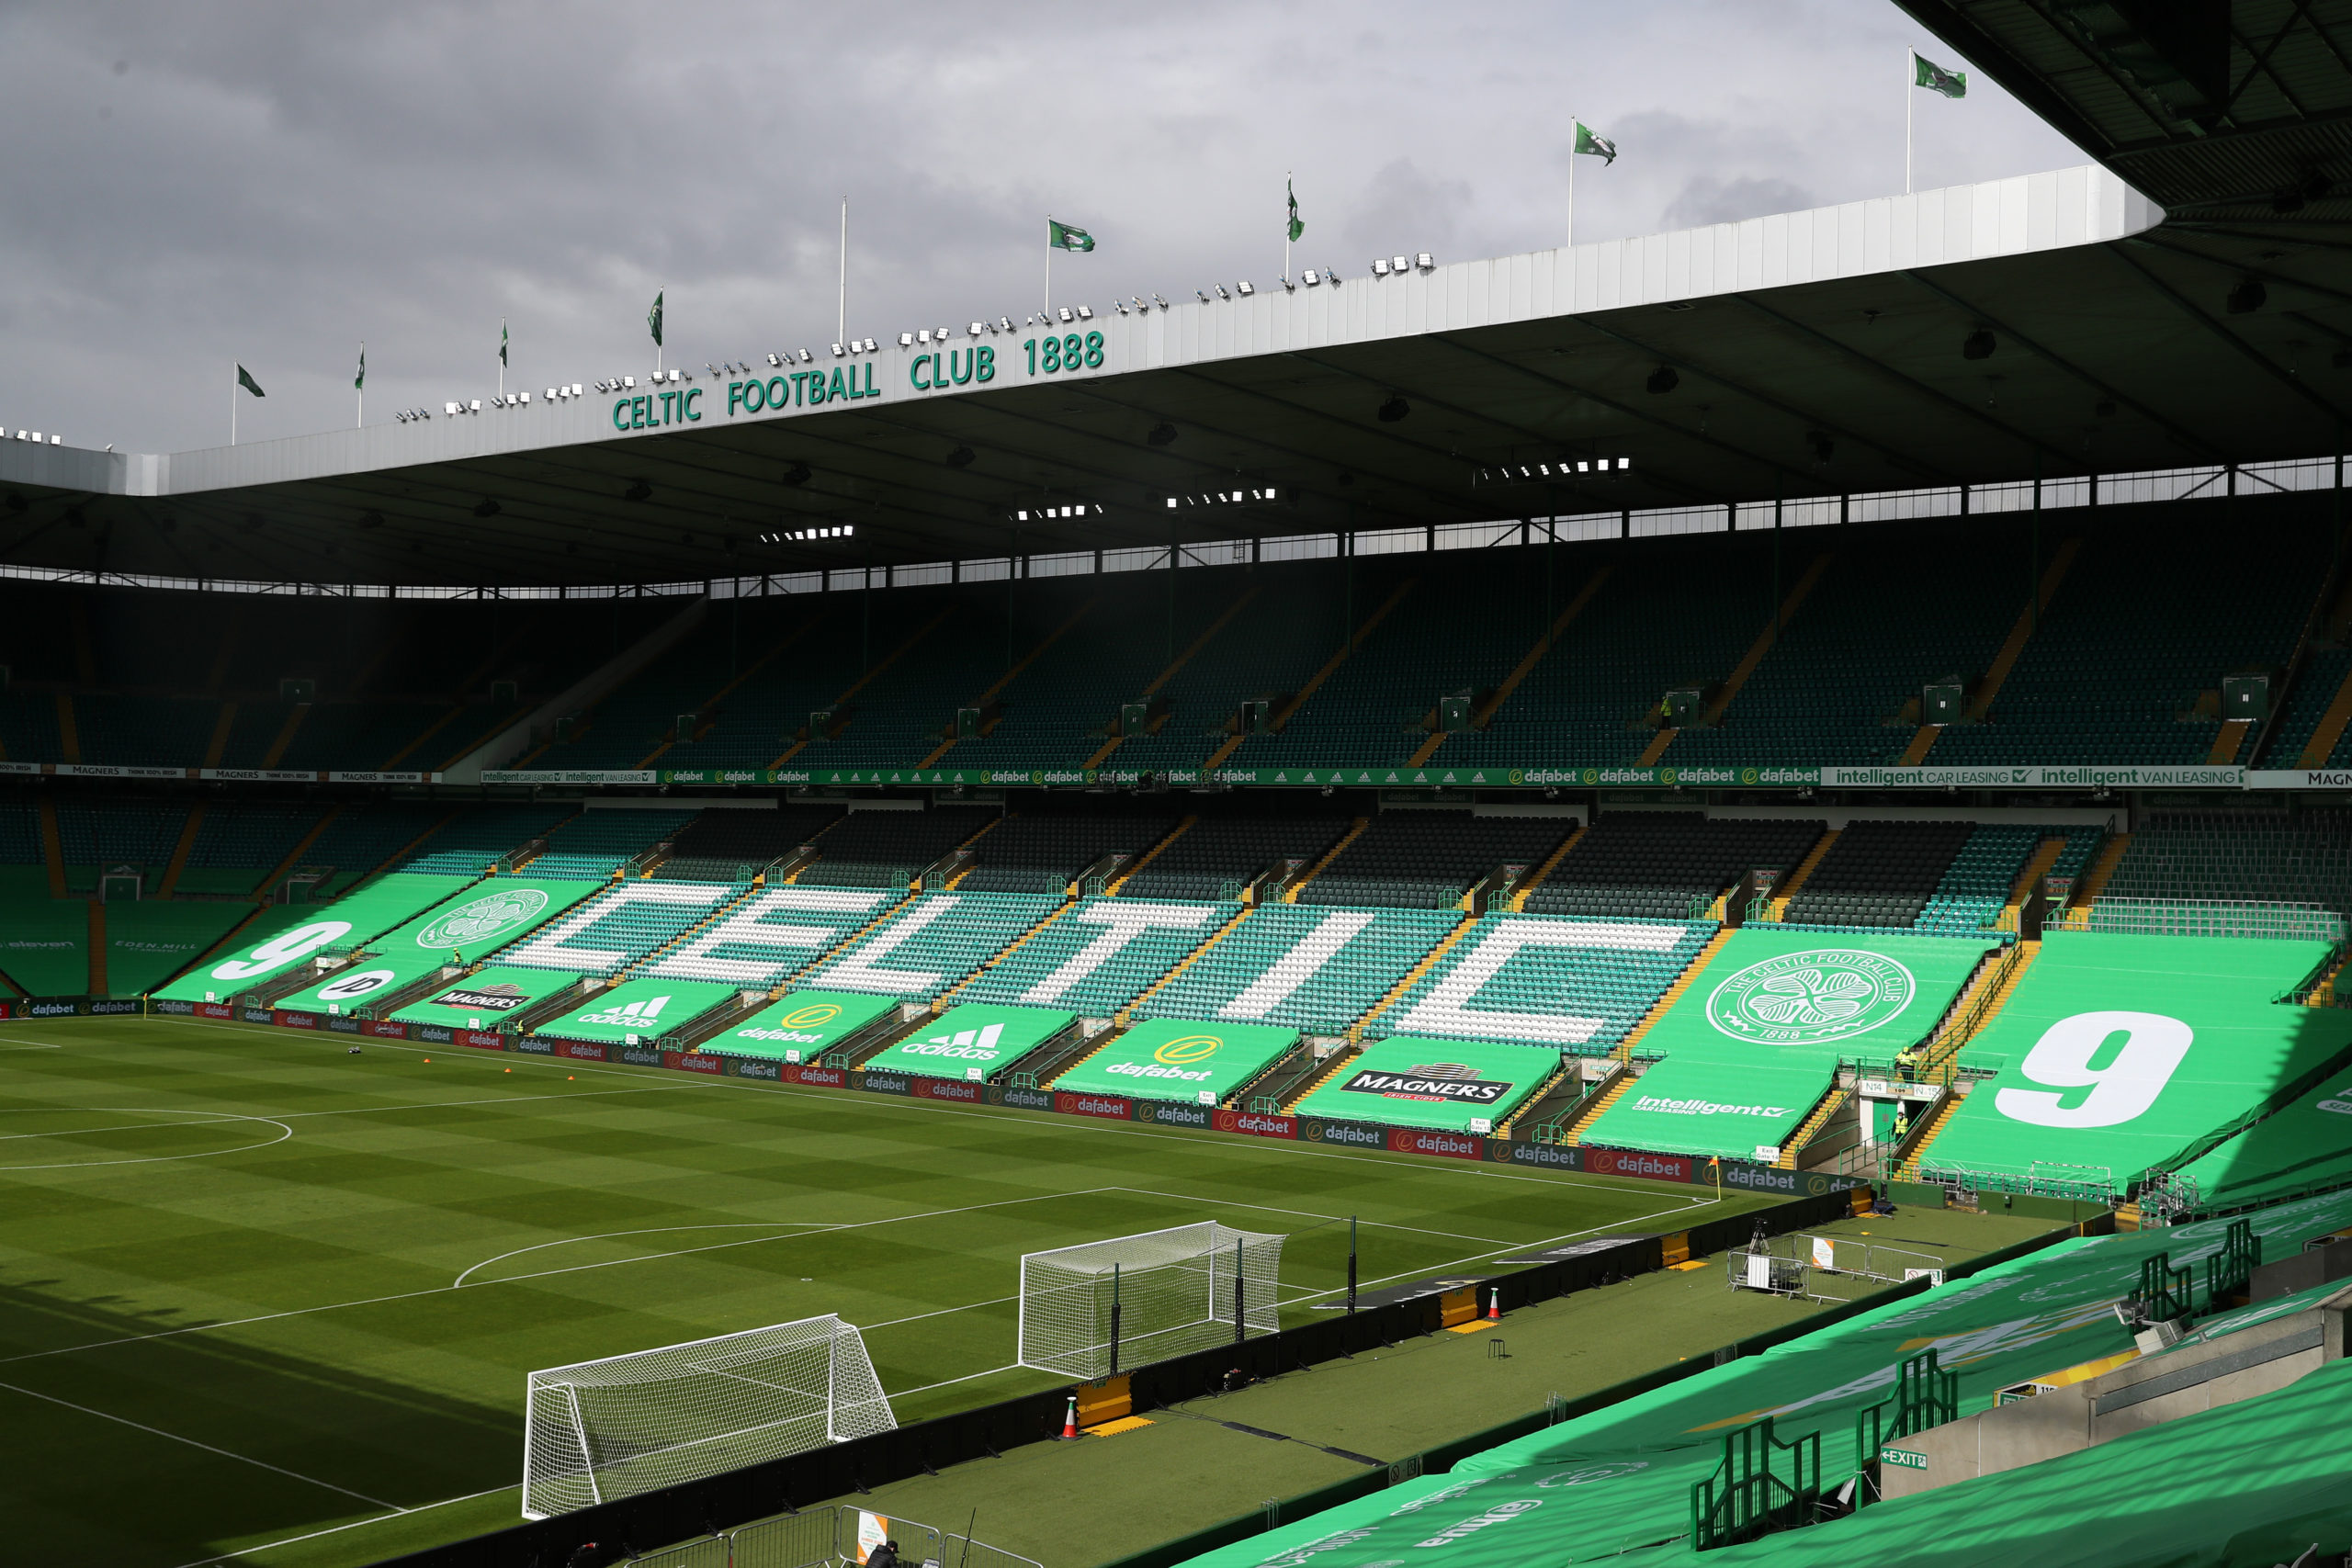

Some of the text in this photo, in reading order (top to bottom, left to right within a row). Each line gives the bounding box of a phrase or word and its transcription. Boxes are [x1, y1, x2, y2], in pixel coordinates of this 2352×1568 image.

[612, 331, 1103, 430] CELTIC FOOTBALL CLUB 1888
[73, 765, 119, 775] MAGNERS
[216, 771, 259, 779] MAGNERS
[342, 773, 378, 781] MAGNERS
[483, 772, 519, 783] intelligent
[566, 772, 604, 783] intelligent
[673, 771, 703, 782] dafabet
[724, 771, 755, 782] dafabet
[777, 771, 809, 782] dafabet
[992, 771, 1029, 783] dafabet
[1044, 771, 1080, 783] dafabet
[1524, 769, 1577, 783] dafabet
[1600, 768, 1654, 783] dafabet
[1678, 768, 1735, 784] dafabet
[1759, 768, 1819, 784] dafabet
[1837, 769, 2008, 785] intelligent CAR LEASING
[2041, 768, 2235, 785] intelligent VAN LEASING
[211, 921, 352, 980] 9
[503, 880, 1689, 1046] CELTIC
[327, 976, 383, 994] JD
[1725, 953, 1904, 1002] THE CELTIC FOOTBALL CLUB
[32, 1001, 74, 1015] dafabet
[92, 1000, 136, 1013] dafabet
[437, 992, 523, 1008] MAGNERS
[205, 1006, 230, 1018] dafabet
[245, 1010, 271, 1022] dafabet
[578, 1011, 659, 1028] adidas
[287, 1014, 313, 1027] dafabet
[330, 1019, 357, 1032] dafabet
[421, 1028, 450, 1041] dafabet
[469, 1032, 499, 1045] dafabet
[737, 1027, 823, 1043] dafabet
[1758, 1029, 1801, 1040] 1888
[519, 1037, 551, 1051] dafabet
[571, 1043, 602, 1058] dafabet
[901, 1043, 1001, 1060] adidas
[624, 1049, 659, 1064] dafabet
[682, 1055, 717, 1070] dafabet
[800, 1069, 839, 1085] dafabet
[1105, 1062, 1213, 1081] dafabet
[1995, 1010, 2194, 1128] 9
[865, 1075, 906, 1091] dafabet
[1351, 1074, 1501, 1100] MAGNERS
[933, 1083, 975, 1100] dafabet
[1004, 1090, 1048, 1107] dafabet
[1078, 1098, 1125, 1115] dafabet
[1635, 1095, 1763, 1116] intelligent
[1654, 1106, 1697, 1115] LEASING
[1157, 1106, 1204, 1123] dafabet
[1238, 1114, 1289, 1135] dafabet
[1326, 1124, 1380, 1144] dafabet
[1417, 1134, 1474, 1154] dafabet
[1514, 1145, 1576, 1165] dafabet
[1617, 1156, 1680, 1176] dafabet
[1727, 1168, 1795, 1190] dafabet
[1889, 1450, 1918, 1466] EXIT
